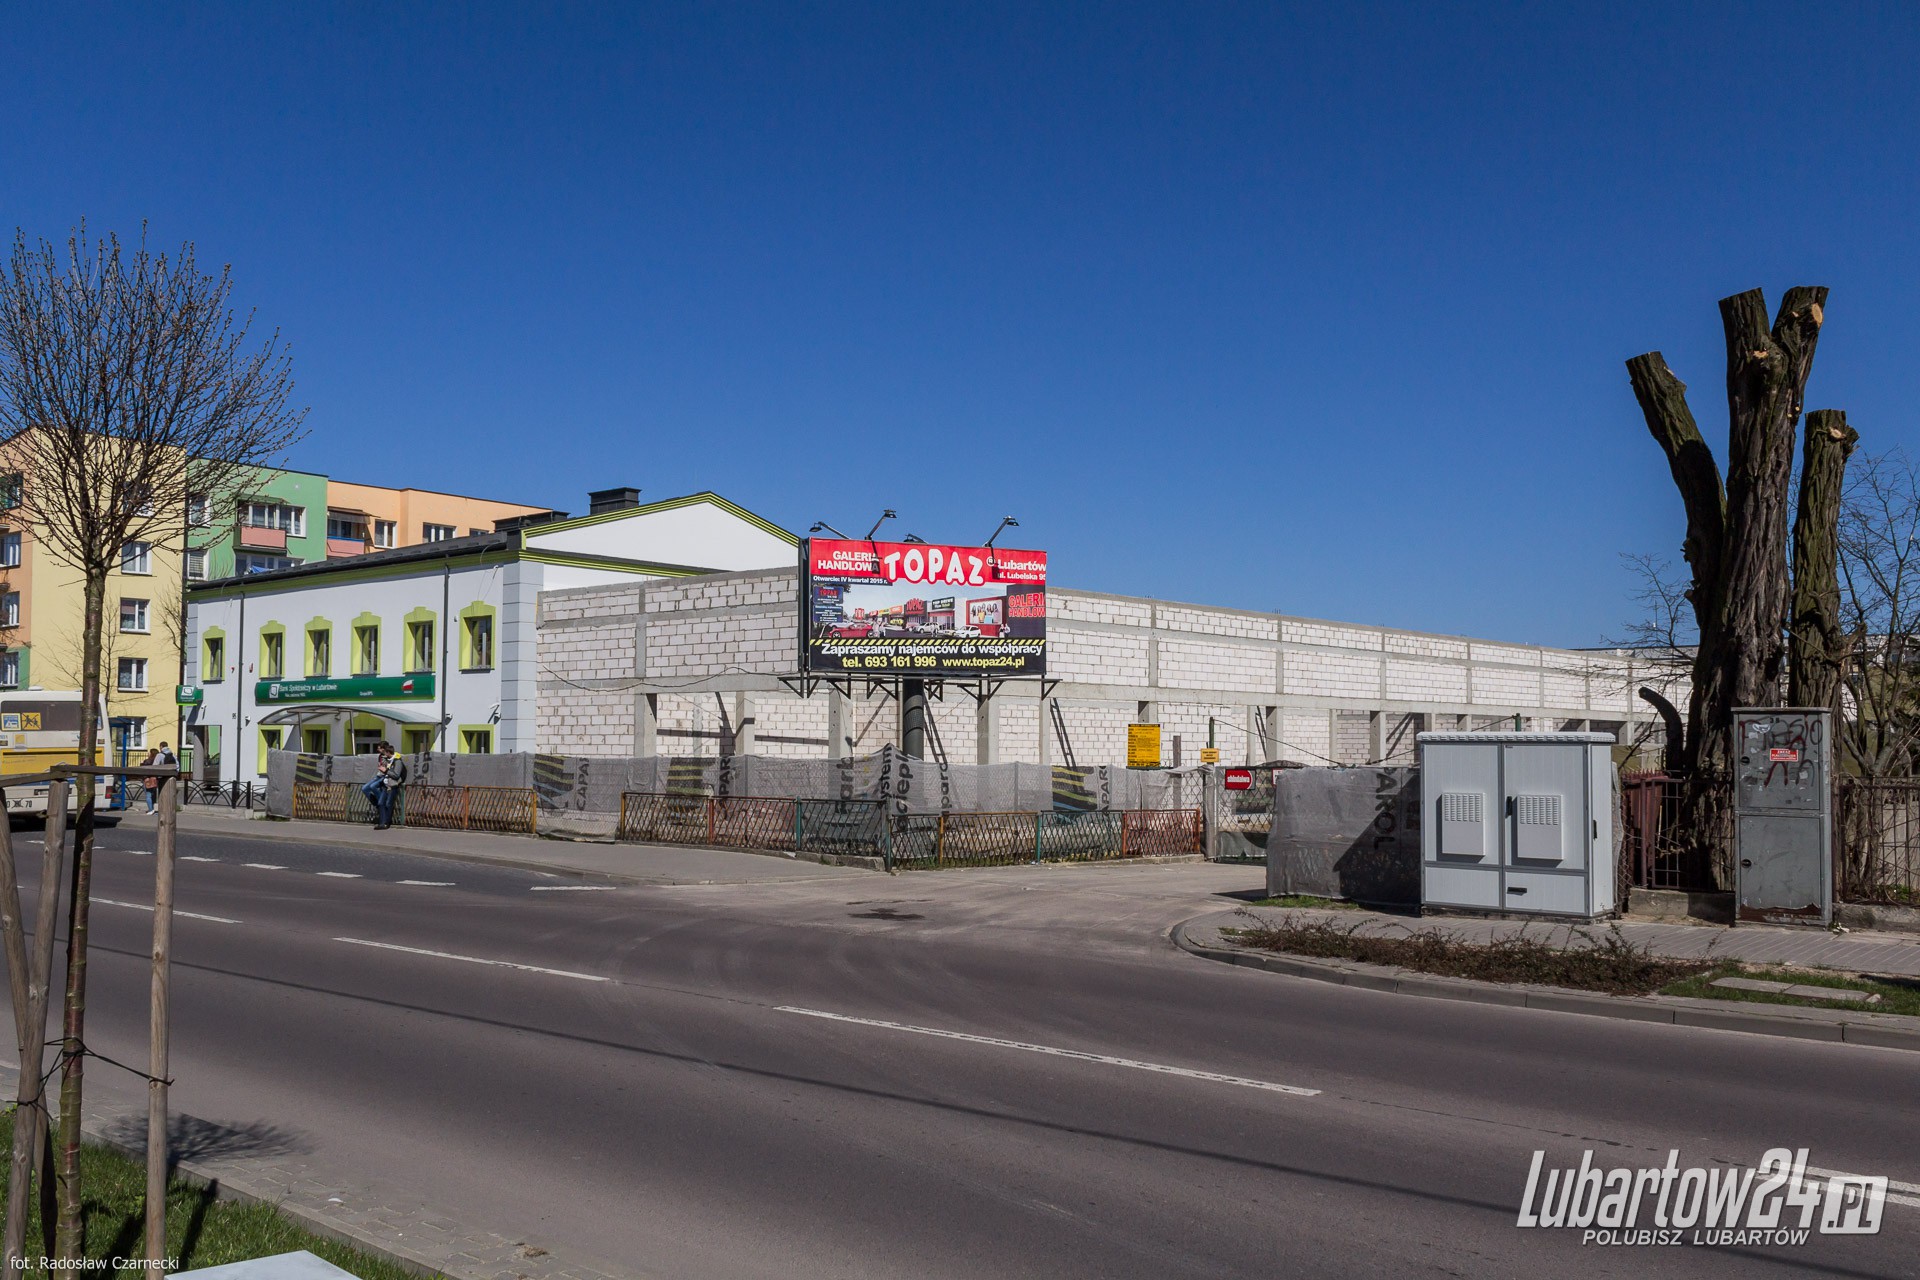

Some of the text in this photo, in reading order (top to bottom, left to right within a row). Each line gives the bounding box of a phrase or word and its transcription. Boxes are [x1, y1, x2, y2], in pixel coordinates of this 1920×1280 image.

[832, 550, 880, 562] GALERIA
[818, 560, 880, 572] HANDLOWA
[884, 548, 985, 585] TOPAZ
[997, 558, 1047, 571] Lubartów
[1007, 572, 1038, 580] Lubelska
[1008, 592, 1046, 608] GALERI
[821, 642, 1043, 656] Zapraszamy najemców do współpracy
[842, 656, 1025, 668] tel. 693 161 996 www.topaz24.pl
